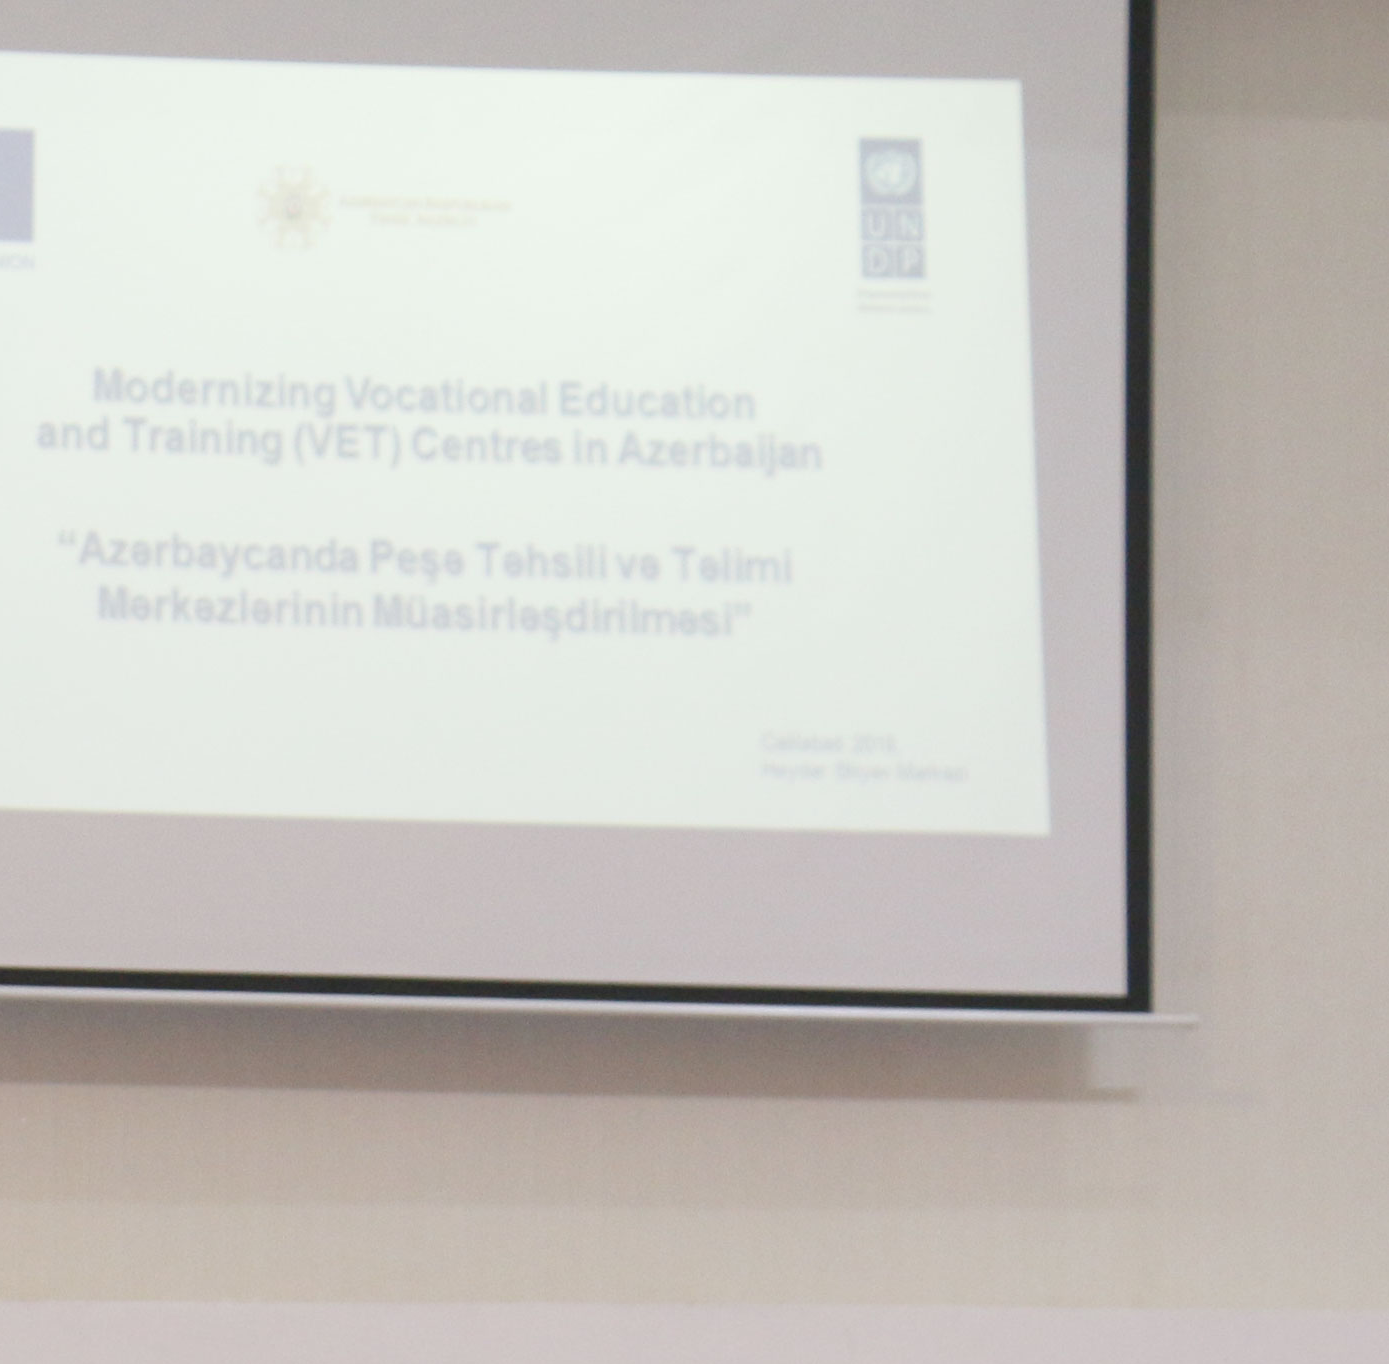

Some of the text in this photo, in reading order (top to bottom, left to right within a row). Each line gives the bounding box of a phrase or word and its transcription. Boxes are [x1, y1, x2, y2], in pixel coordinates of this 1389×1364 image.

[93, 366, 756, 420] Modernizing Vocational Education
[37, 415, 823, 478] and Training (VET) Centres in Azerbaijan
[58, 530, 792, 583] “Azərbaycanda Peşə Təhsili və Təlimi
[97, 584, 364, 627] Mərkəzlərinin
